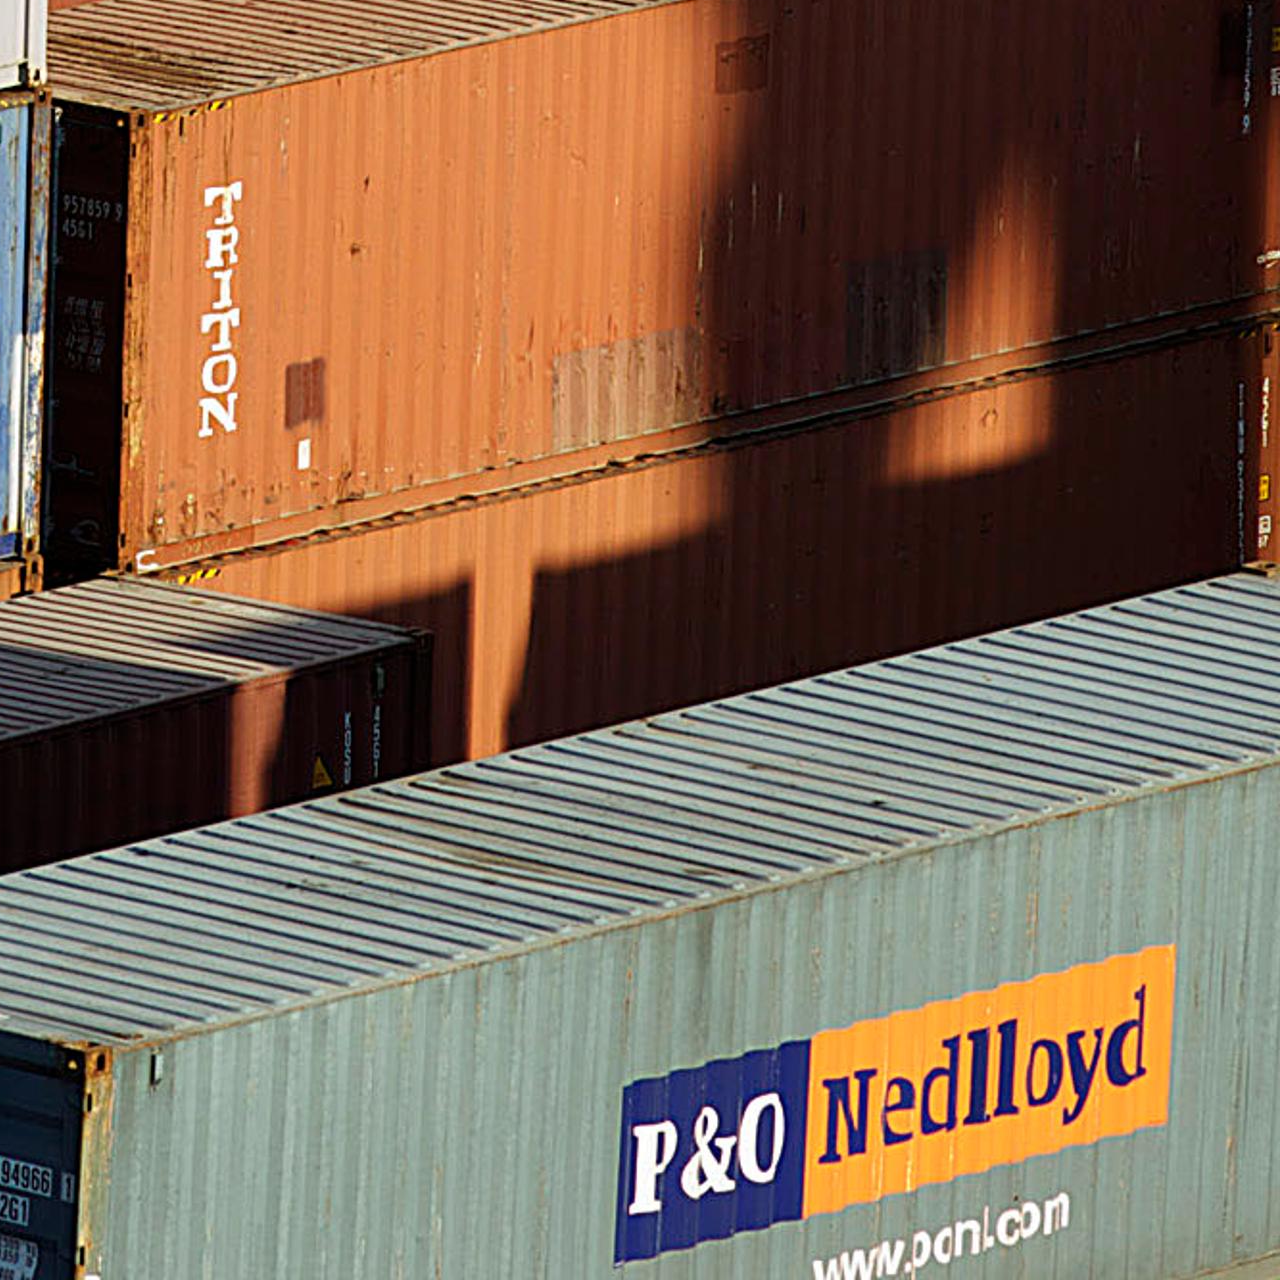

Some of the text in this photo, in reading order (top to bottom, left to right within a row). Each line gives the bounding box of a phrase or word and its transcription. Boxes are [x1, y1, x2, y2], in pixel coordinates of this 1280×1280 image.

[61, 192, 111, 216] 957859
[61, 214, 94, 240] 45G1
[196, 181, 243, 440] TRITON
[627, 983, 1148, 1217] P&O Nedlloyd
